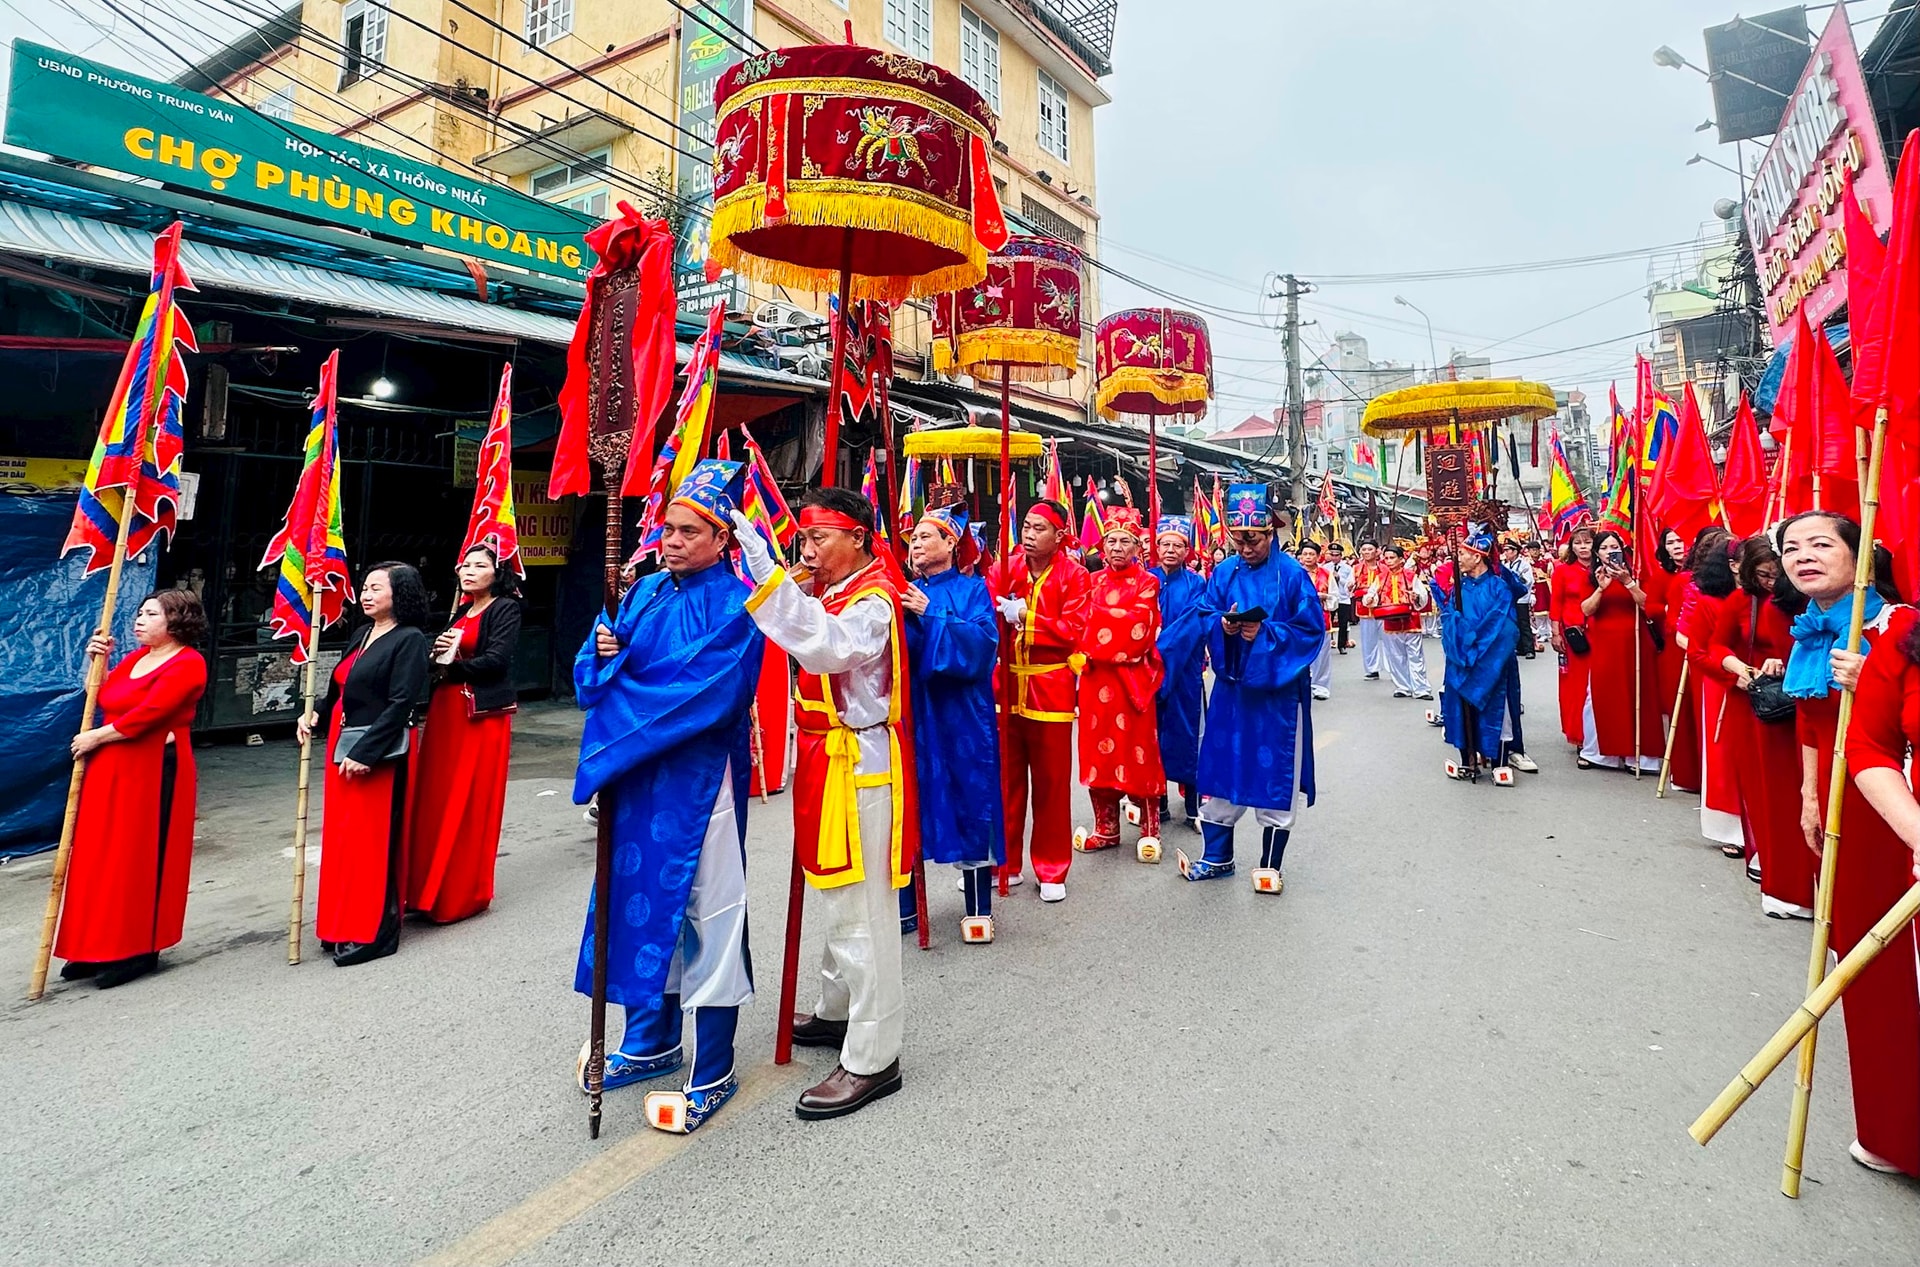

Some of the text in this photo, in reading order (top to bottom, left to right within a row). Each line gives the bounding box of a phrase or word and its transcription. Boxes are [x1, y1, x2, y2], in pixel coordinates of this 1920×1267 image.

[38, 57, 234, 124] UBND PHƯỜNG TRUNG VĂN
[285, 137, 488, 206] HỢP TÁC XÃ THỐNG NHẤT
[1760, 54, 1840, 237] FULL STORE
[124, 127, 582, 269] CHỢ PHÙNG KHOANG
[542, 514, 569, 541] LỰC
